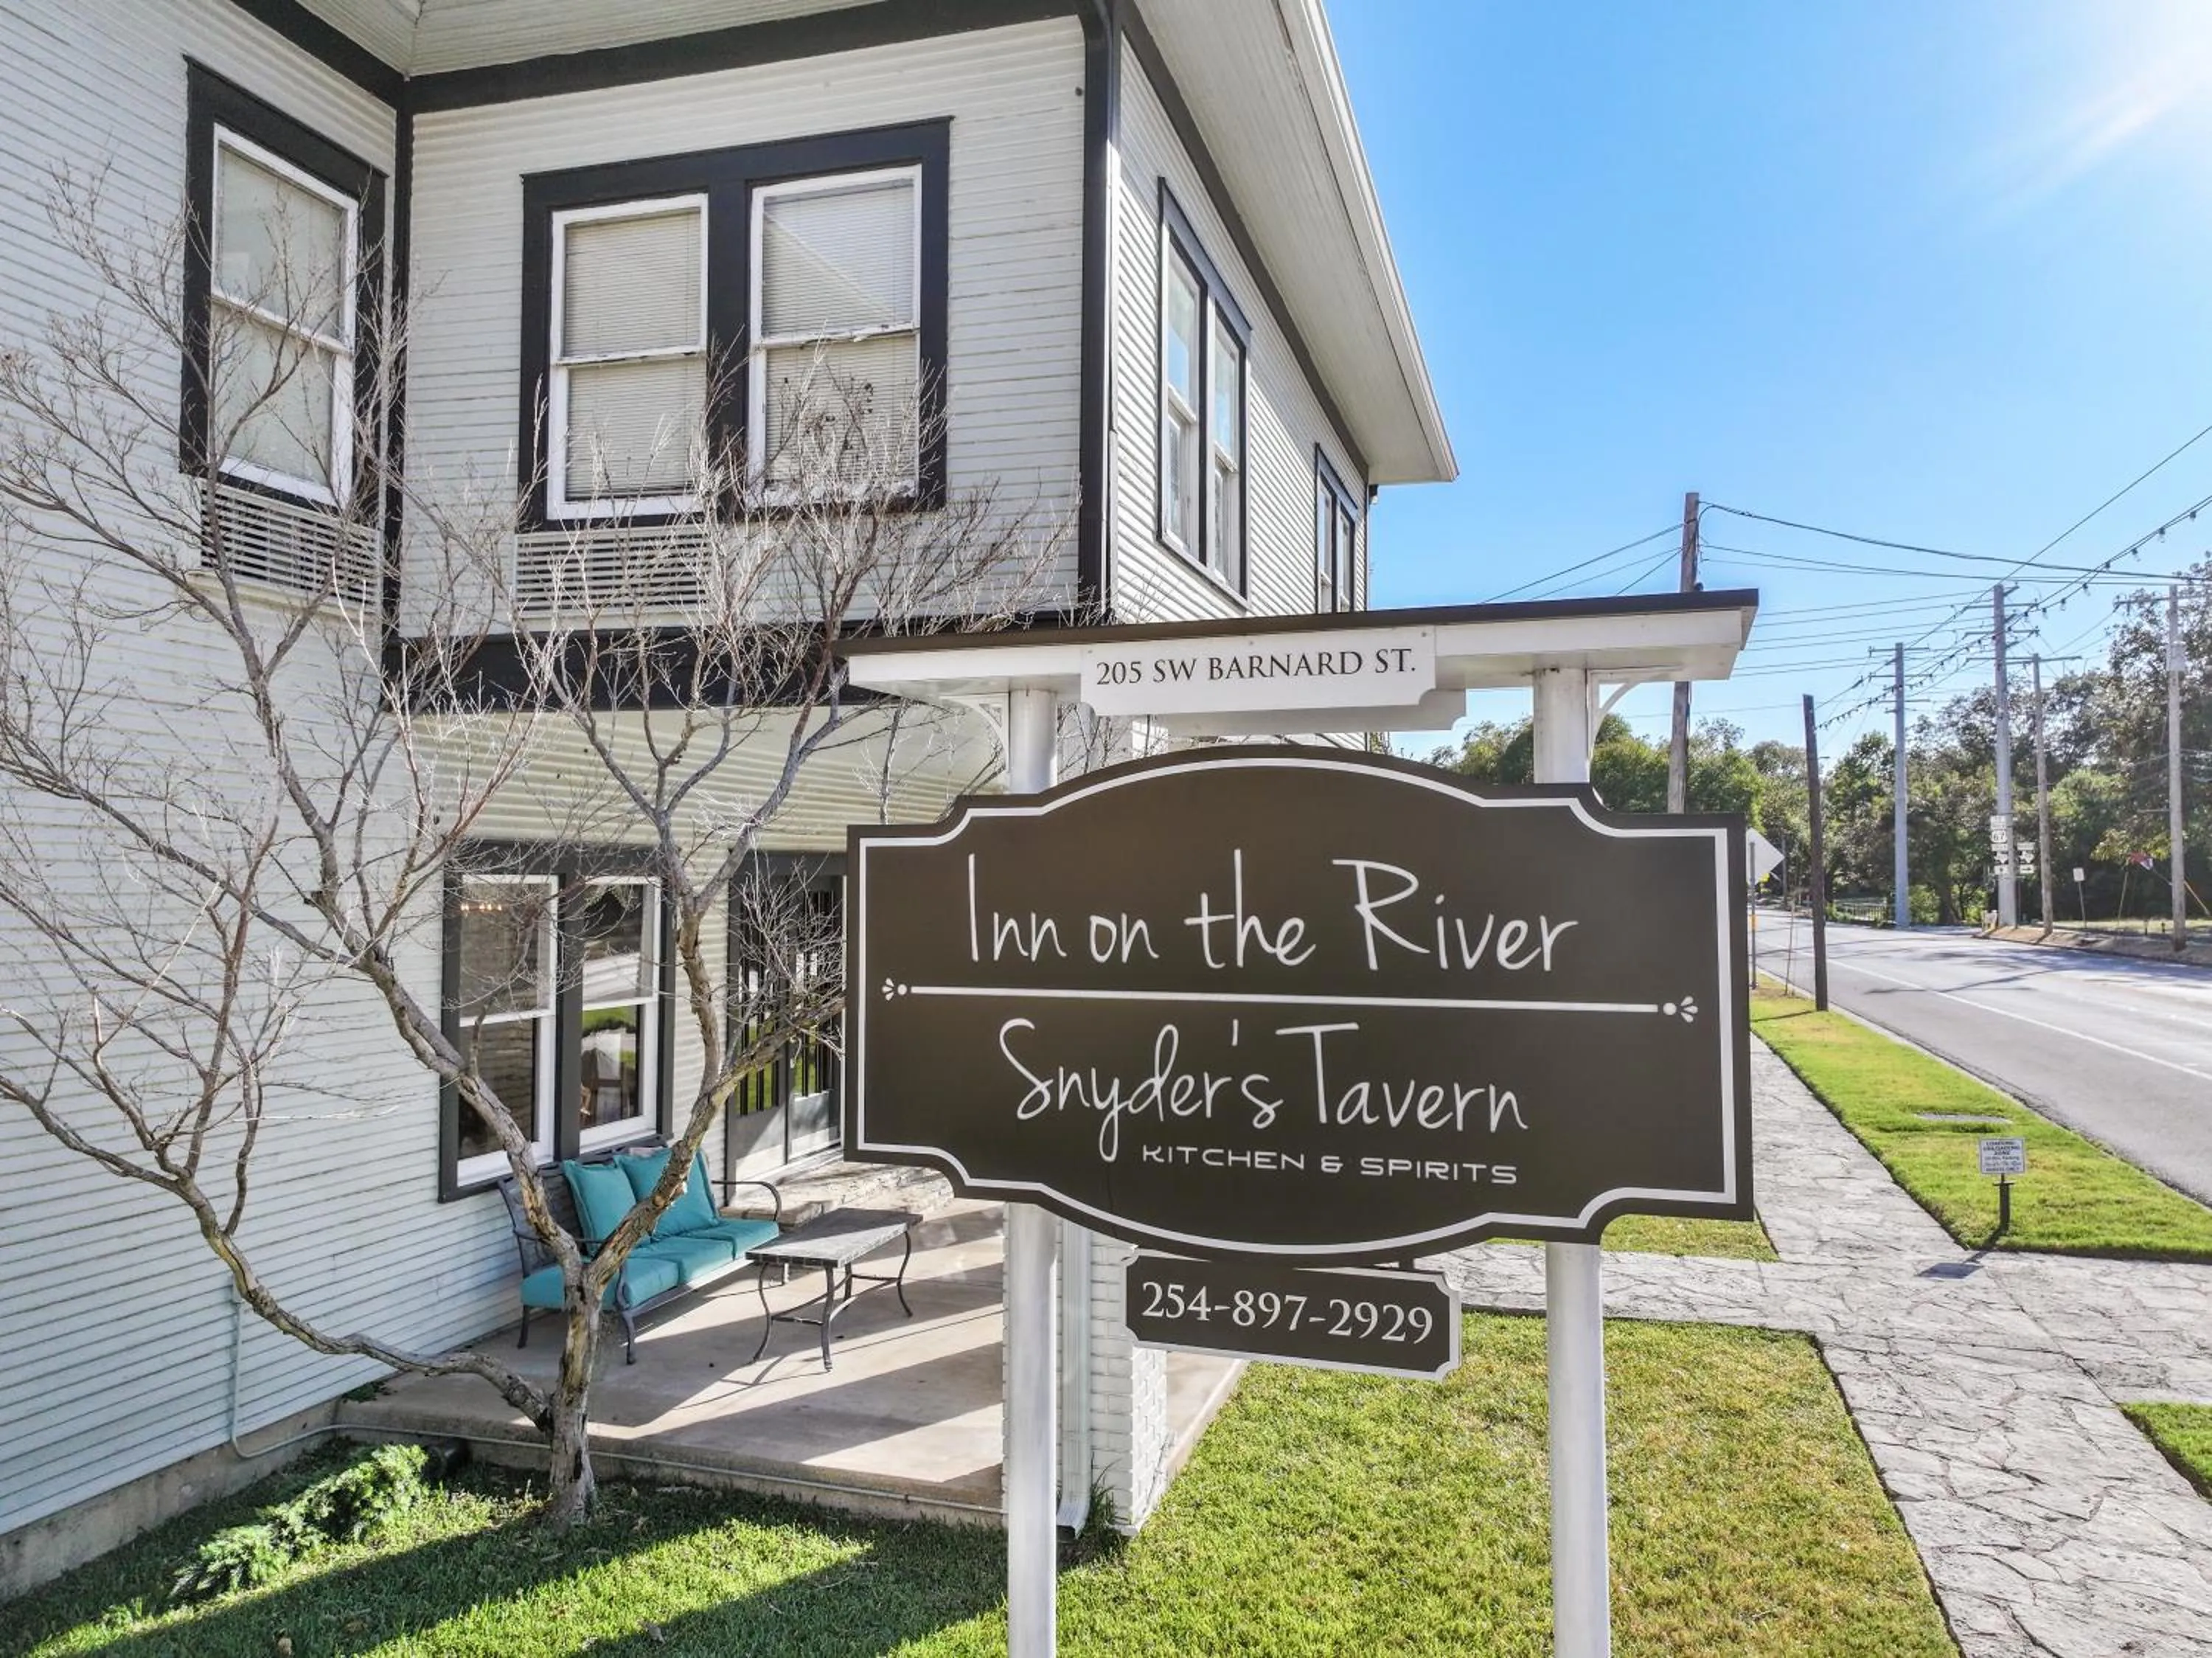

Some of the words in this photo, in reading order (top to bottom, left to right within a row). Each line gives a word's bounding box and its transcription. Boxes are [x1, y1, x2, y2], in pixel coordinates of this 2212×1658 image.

[1096, 661, 1142, 685] 205
[1153, 659, 1197, 683] SW
[1208, 651, 1363, 681] BARNARD
[1374, 648, 1417, 673] ST.
[967, 853, 1068, 962] Inn
[1088, 913, 1160, 963] on
[1184, 848, 1317, 969] the
[1332, 859, 1579, 972] River
[998, 1017, 1284, 1162] Snyder's
[1275, 1021, 1528, 1133] Tavern
[1141, 1145, 1305, 1171] KITCHEN
[1320, 1155, 1344, 1173] &
[1360, 1156, 1518, 1184] SPIRITS
[1141, 1280, 1433, 1345] 254-897-2929
